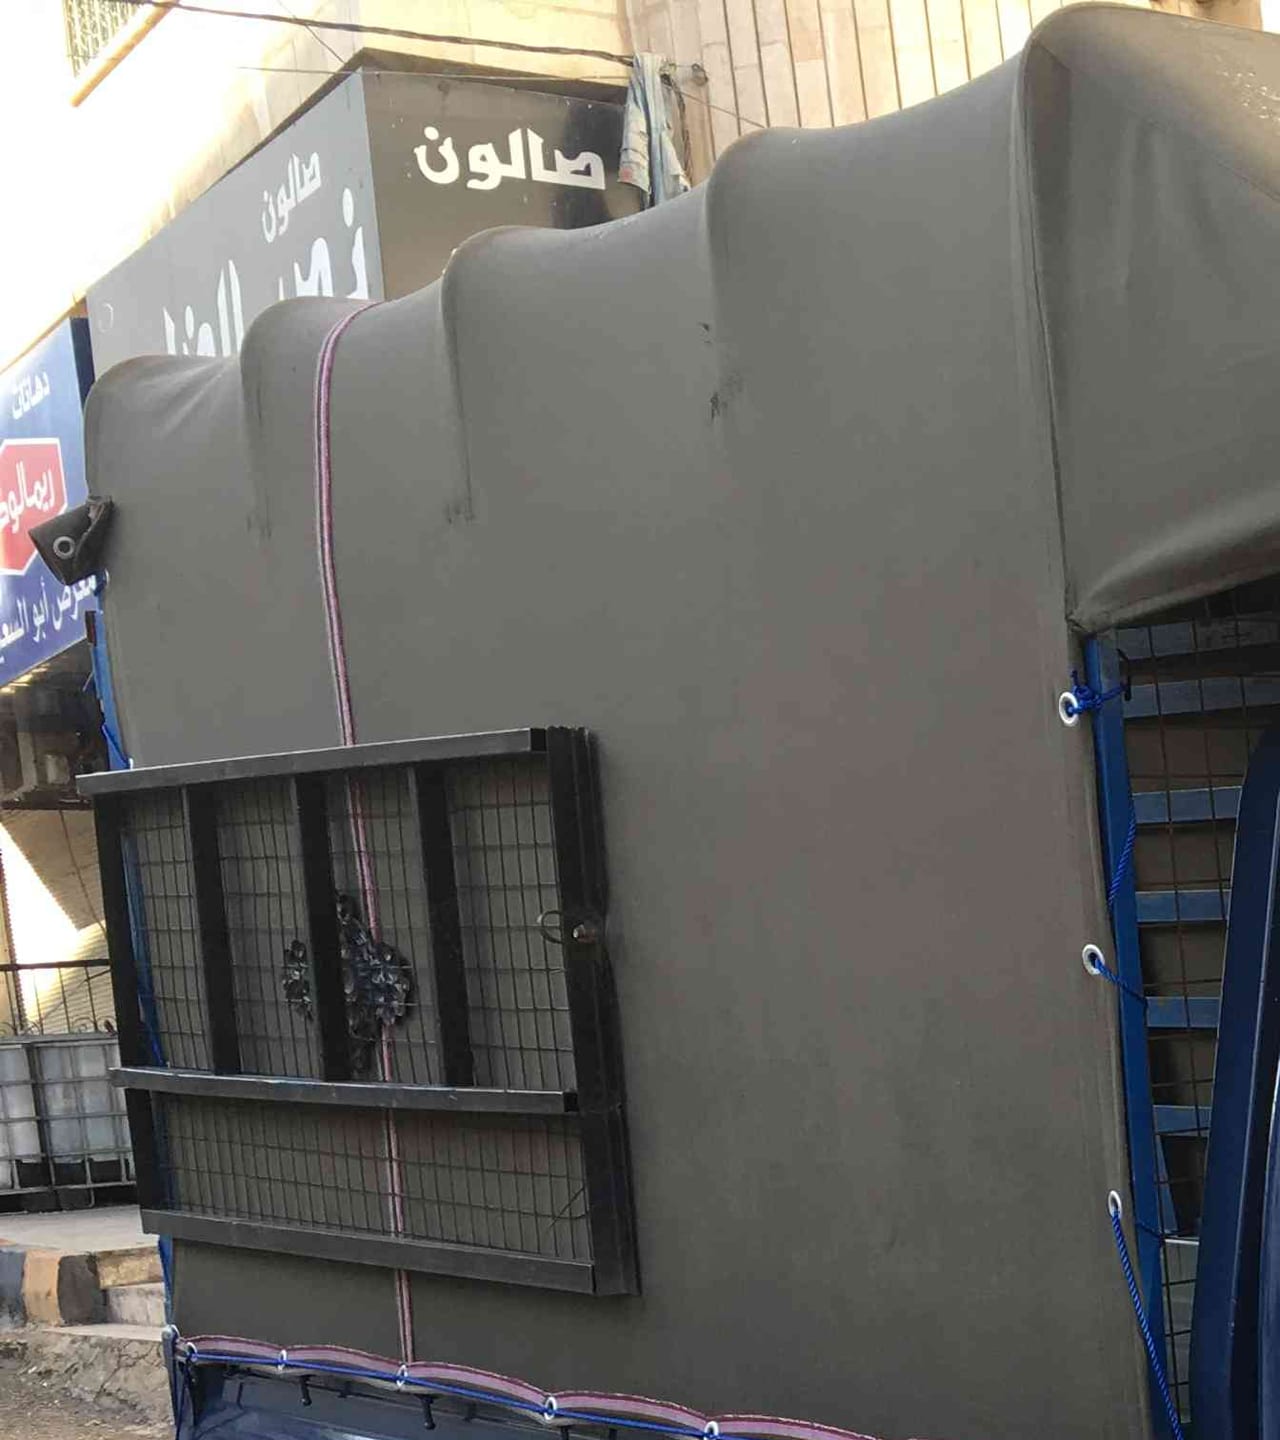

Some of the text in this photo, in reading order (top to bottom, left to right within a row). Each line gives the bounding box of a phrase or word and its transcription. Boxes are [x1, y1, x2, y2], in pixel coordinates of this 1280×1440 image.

[413, 126, 606, 190] صالون
[261, 151, 322, 243] صالون
[33, 575, 49, 643] أبو
